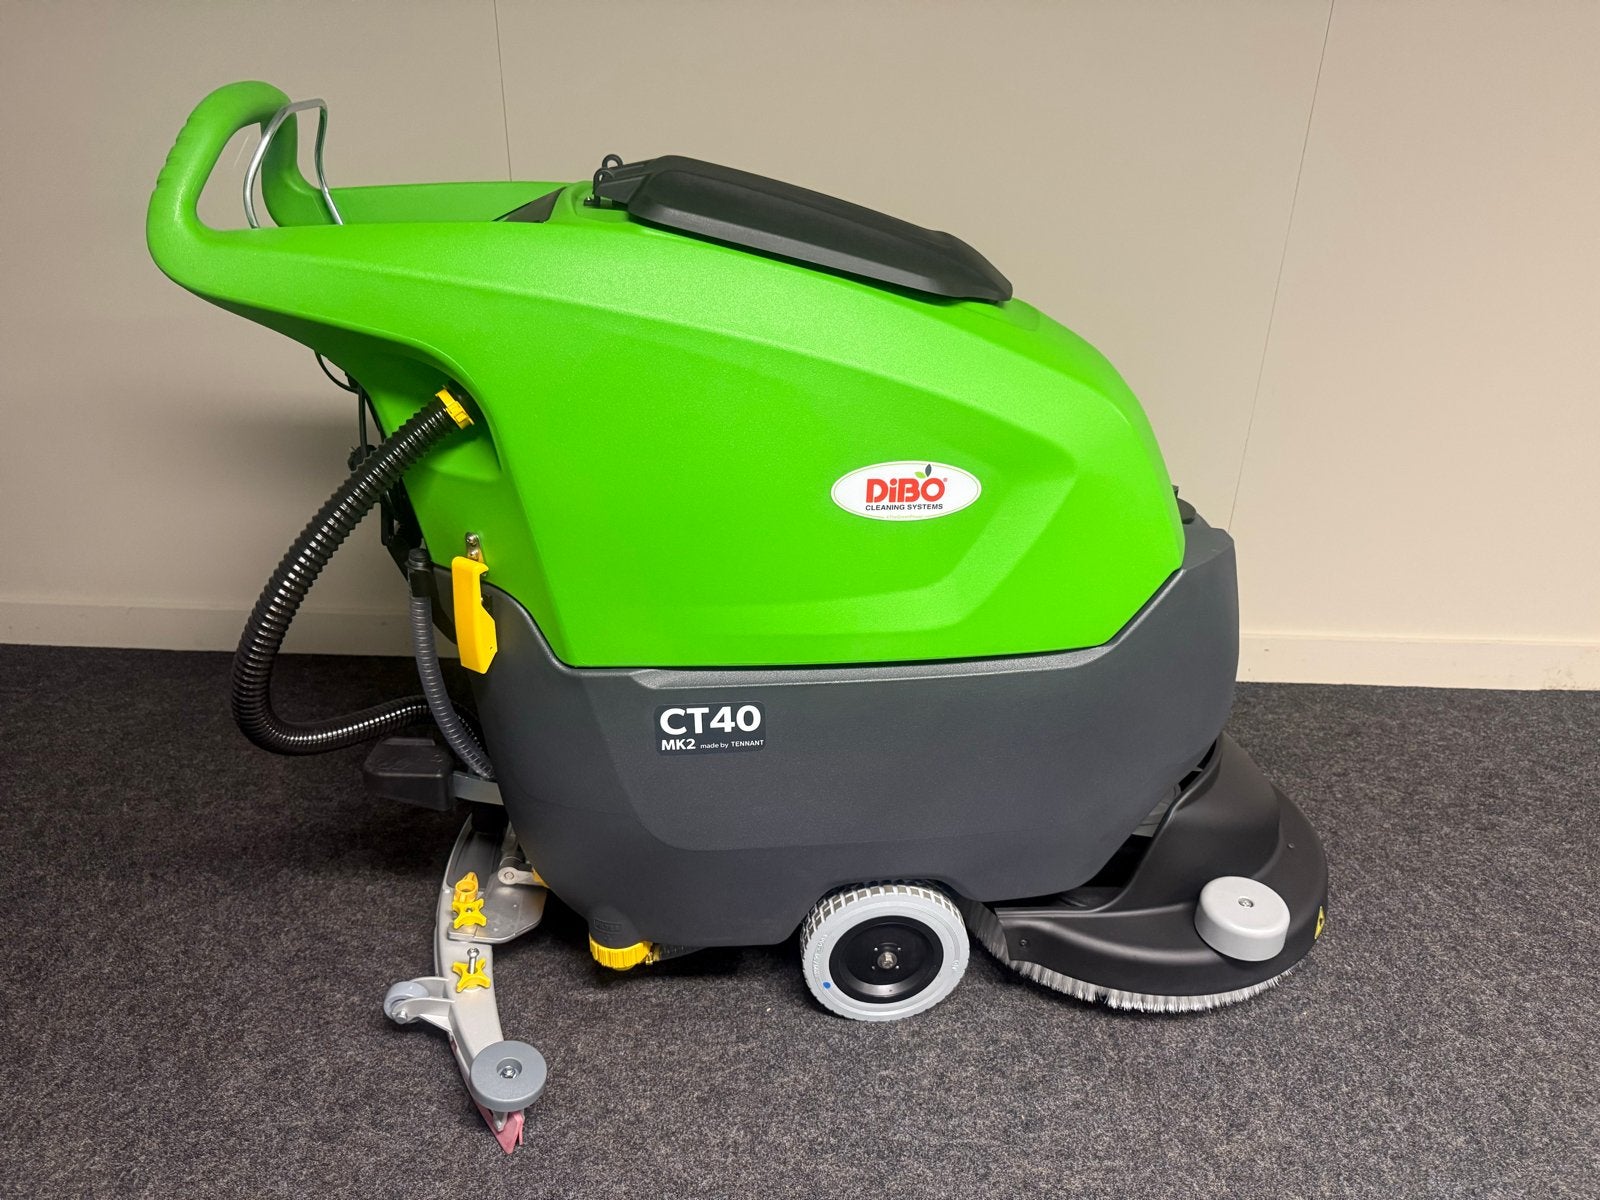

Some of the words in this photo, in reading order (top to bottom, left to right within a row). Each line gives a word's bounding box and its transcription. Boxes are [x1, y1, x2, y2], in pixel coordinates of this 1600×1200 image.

[660, 705, 761, 735] CT40
[661, 738, 696, 750] MK2
[731, 739, 764, 747] TENNANT
